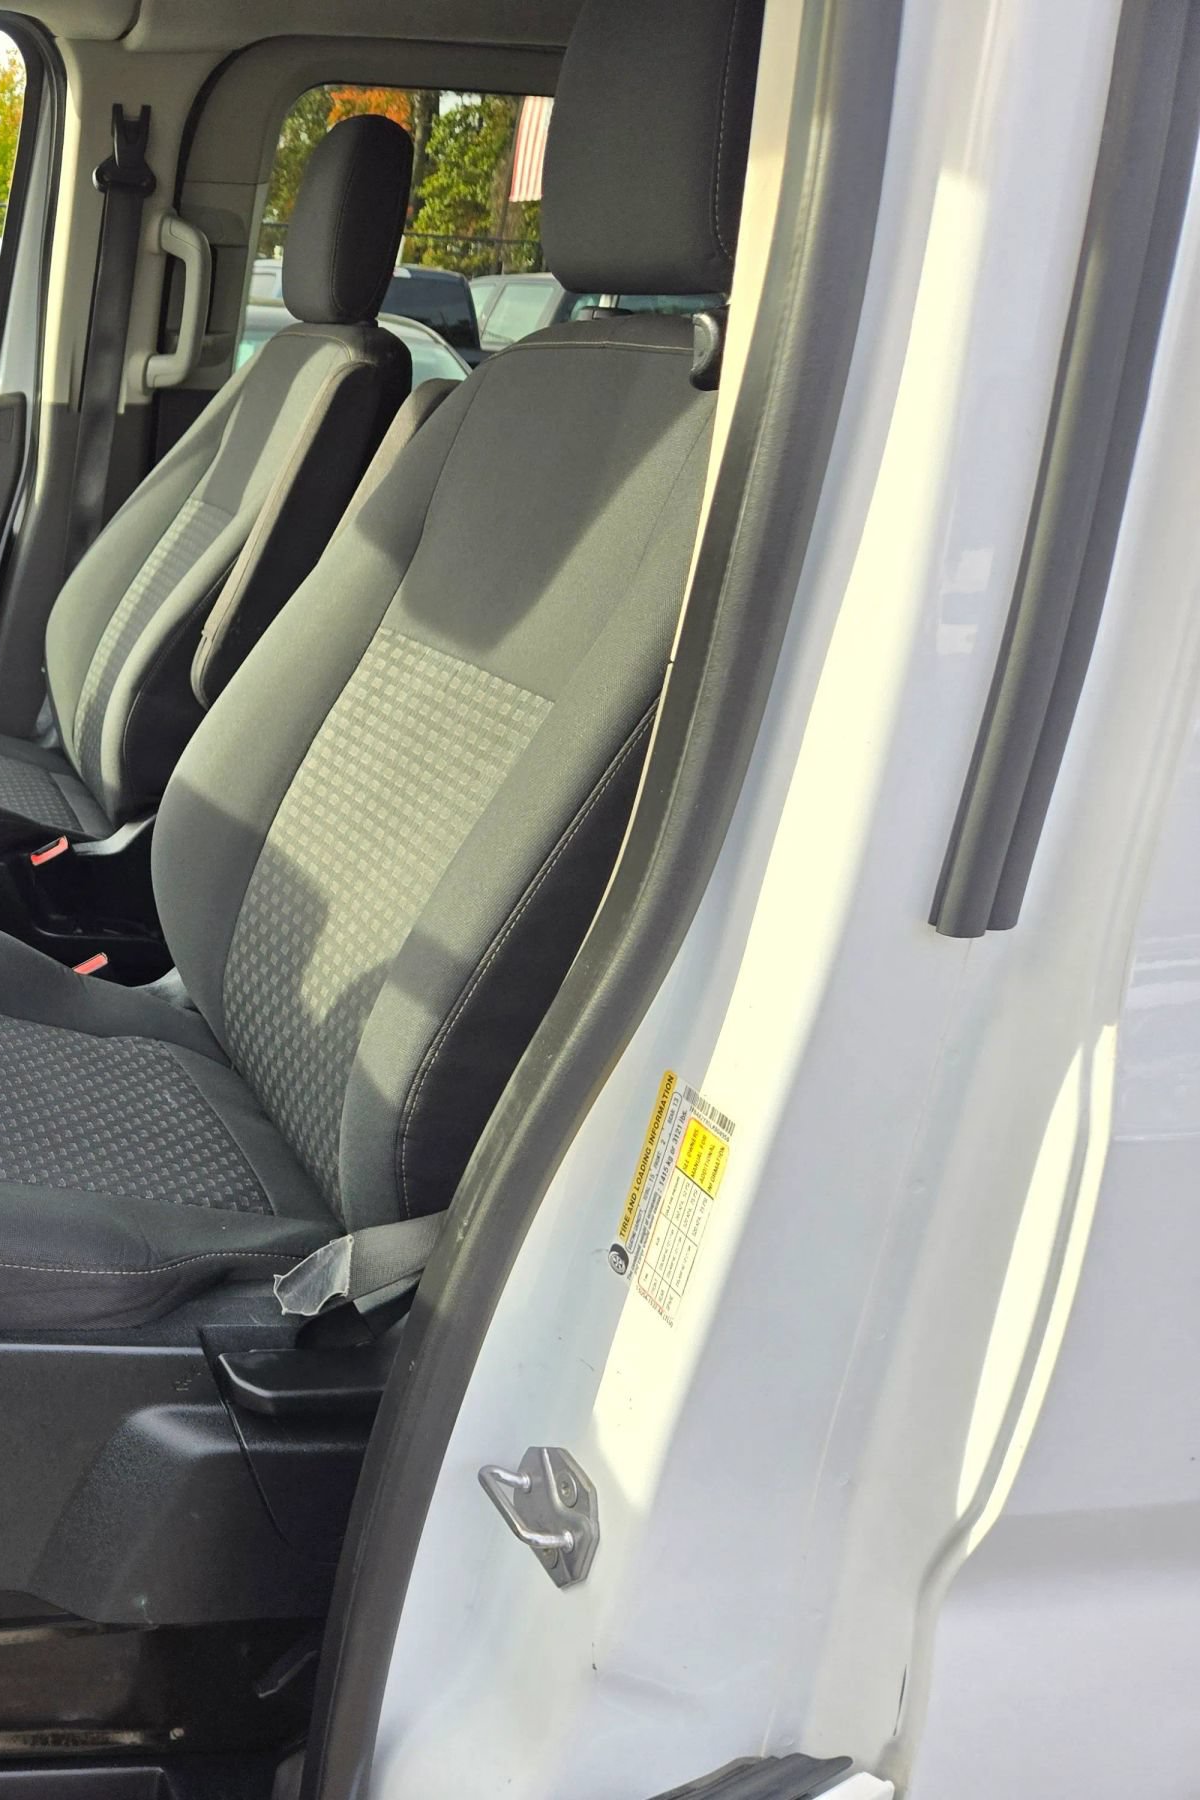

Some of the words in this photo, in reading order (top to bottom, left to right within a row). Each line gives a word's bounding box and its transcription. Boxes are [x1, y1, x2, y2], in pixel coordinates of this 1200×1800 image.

[672, 1124, 682, 1144] 3121
[619, 1215, 630, 1237] TIRE
[627, 1192, 636, 1214] AND
[634, 1147, 651, 1191] LOADING
[648, 1075, 674, 1145] INFORMATION
[665, 1155, 673, 1166] kg
[670, 1145, 675, 1155] or
[690, 1152, 702, 1179] MANUAL
[699, 1134, 707, 1149] FOR
[699, 1145, 715, 1184] ADDITIONAL
[659, 1166, 668, 1186] 1415
[707, 1147, 725, 1193] INFORMATION
